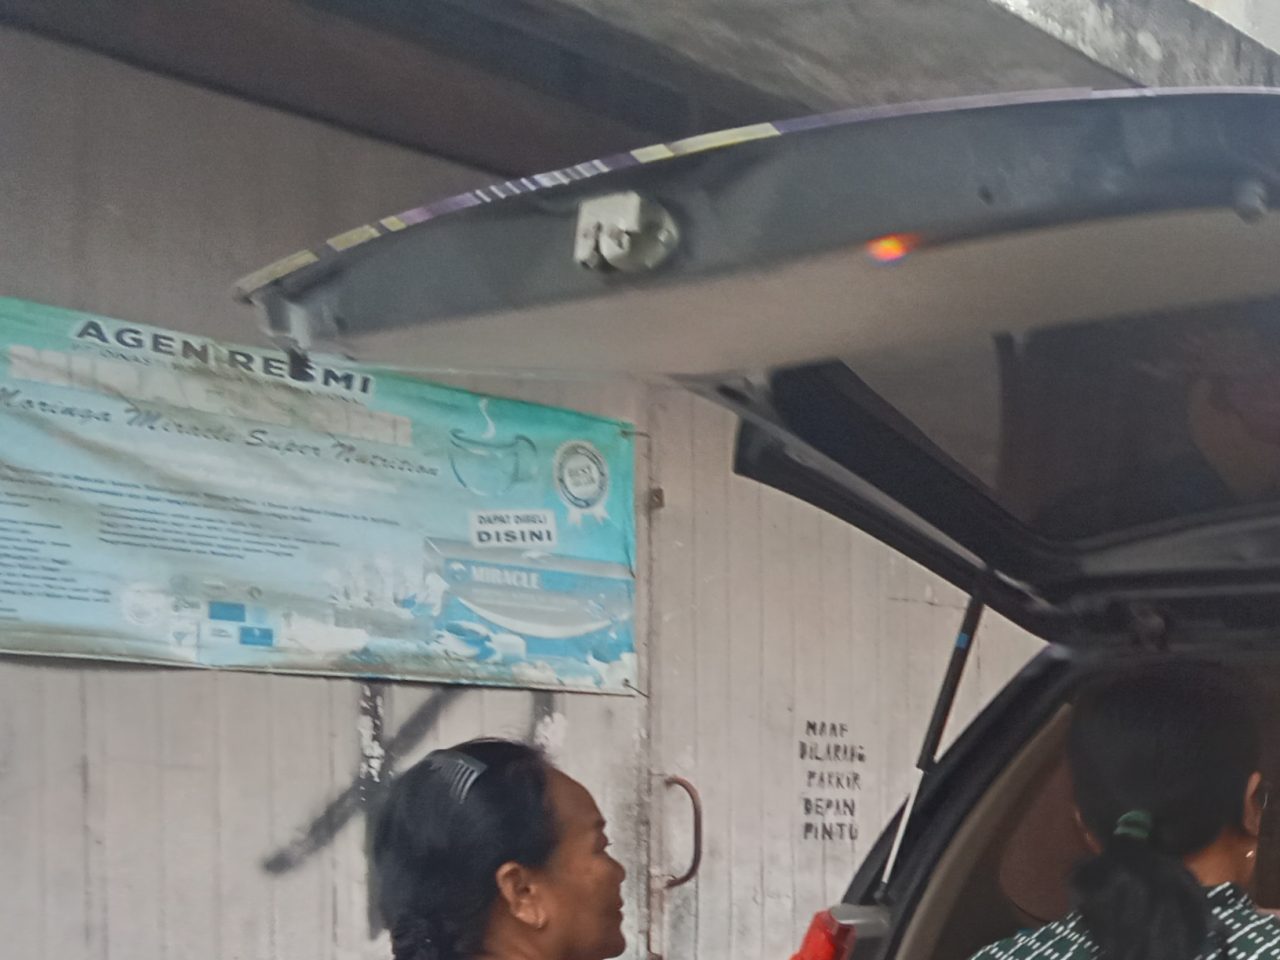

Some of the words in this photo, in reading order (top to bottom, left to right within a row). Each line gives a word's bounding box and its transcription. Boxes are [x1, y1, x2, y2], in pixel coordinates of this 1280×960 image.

[77, 321, 209, 363] AGEN
[477, 530, 552, 544] DISINI
[471, 565, 541, 589] MIRACLE
[803, 822, 858, 840] PINTU
